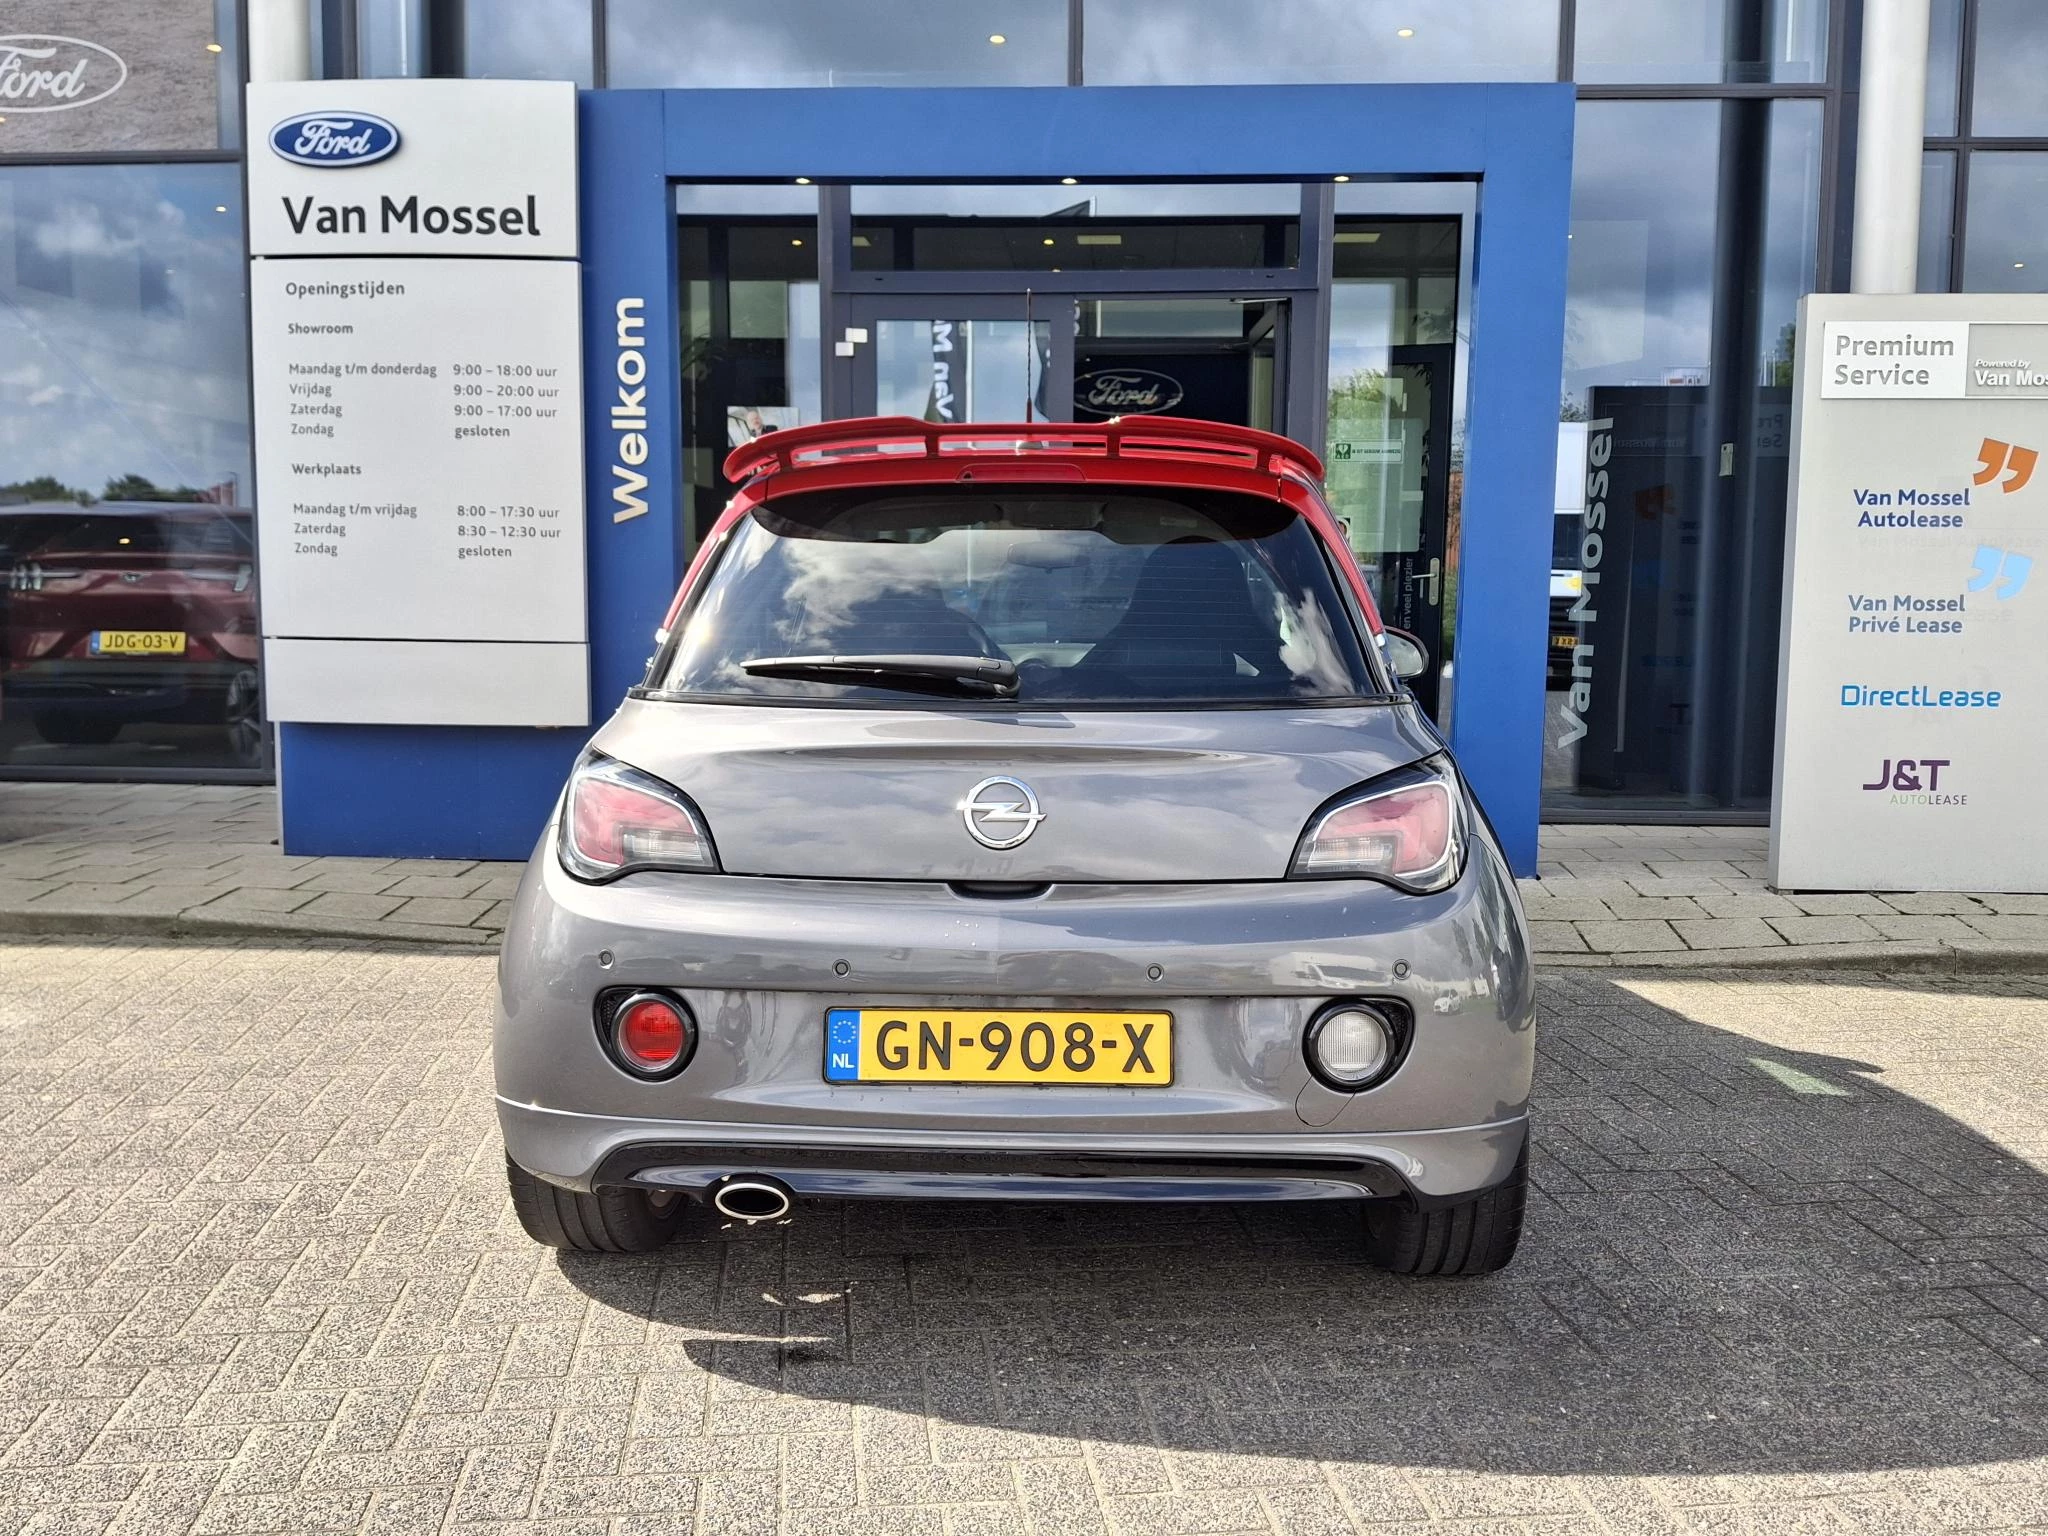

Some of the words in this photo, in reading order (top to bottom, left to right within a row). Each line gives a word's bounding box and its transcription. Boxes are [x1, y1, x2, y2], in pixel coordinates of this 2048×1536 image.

[294, 121, 373, 156] Ford
[281, 196, 367, 235] Van
[380, 194, 541, 237] Mossel
[285, 280, 405, 300] Openingstijden
[287, 322, 354, 335] Showroom
[1836, 333, 1954, 357] Premium
[288, 362, 343, 378] Maandag
[344, 362, 368, 375] t/m
[370, 362, 438, 379] donderdag
[452, 363, 483, 376] 9:00
[496, 364, 533, 377] 18:00
[535, 368, 557, 378] uur
[1975, 358, 2016, 369] Powered
[2017, 359, 2032, 370] by
[1834, 362, 1930, 386] Service
[1974, 369, 2011, 387] Van
[289, 382, 333, 399] Vrijdag
[453, 383, 483, 396] 9:00
[496, 384, 535, 398] 20:00
[537, 388, 560, 398] uur
[1088, 375, 1159, 405] Ford
[290, 402, 343, 419] Zaterdag
[453, 404, 484, 417] 9:00
[497, 404, 533, 418] 17:00
[535, 408, 557, 418] uur
[611, 297, 649, 524] Welkom
[290, 423, 335, 438] Zondag
[454, 424, 511, 440] gesloten
[291, 463, 362, 478] Werkplaats
[1853, 488, 1892, 506] Van
[1897, 487, 1971, 506] Mossel
[293, 503, 347, 518] Maandag
[349, 503, 372, 515] t/m
[374, 503, 418, 519] vrijdag
[457, 504, 487, 517] 8:00
[500, 505, 535, 518] 17:30
[538, 509, 559, 519] uur
[1568, 417, 1614, 622] Mossel
[1857, 509, 1964, 528] Autolease
[294, 522, 347, 538] Zaterdag
[457, 524, 487, 537] 8:30
[500, 525, 537, 538] 12:30
[540, 529, 561, 539] uur
[294, 542, 339, 558] Zondag
[457, 544, 512, 560] gesloten
[1847, 594, 1887, 612] Van
[1893, 593, 1966, 612] Mossel
[1848, 615, 1901, 633] Privé
[1906, 616, 1963, 634] Lease
[105, 634, 178, 648] JDG-03-V
[1558, 645, 1593, 749] Van
[1840, 684, 2002, 708] DirectLease
[1862, 759, 1951, 792] J&T
[1889, 794, 1969, 806] AUTOLEASE
[876, 1020, 1155, 1074] GN-908-X
[832, 1053, 855, 1069] NL
